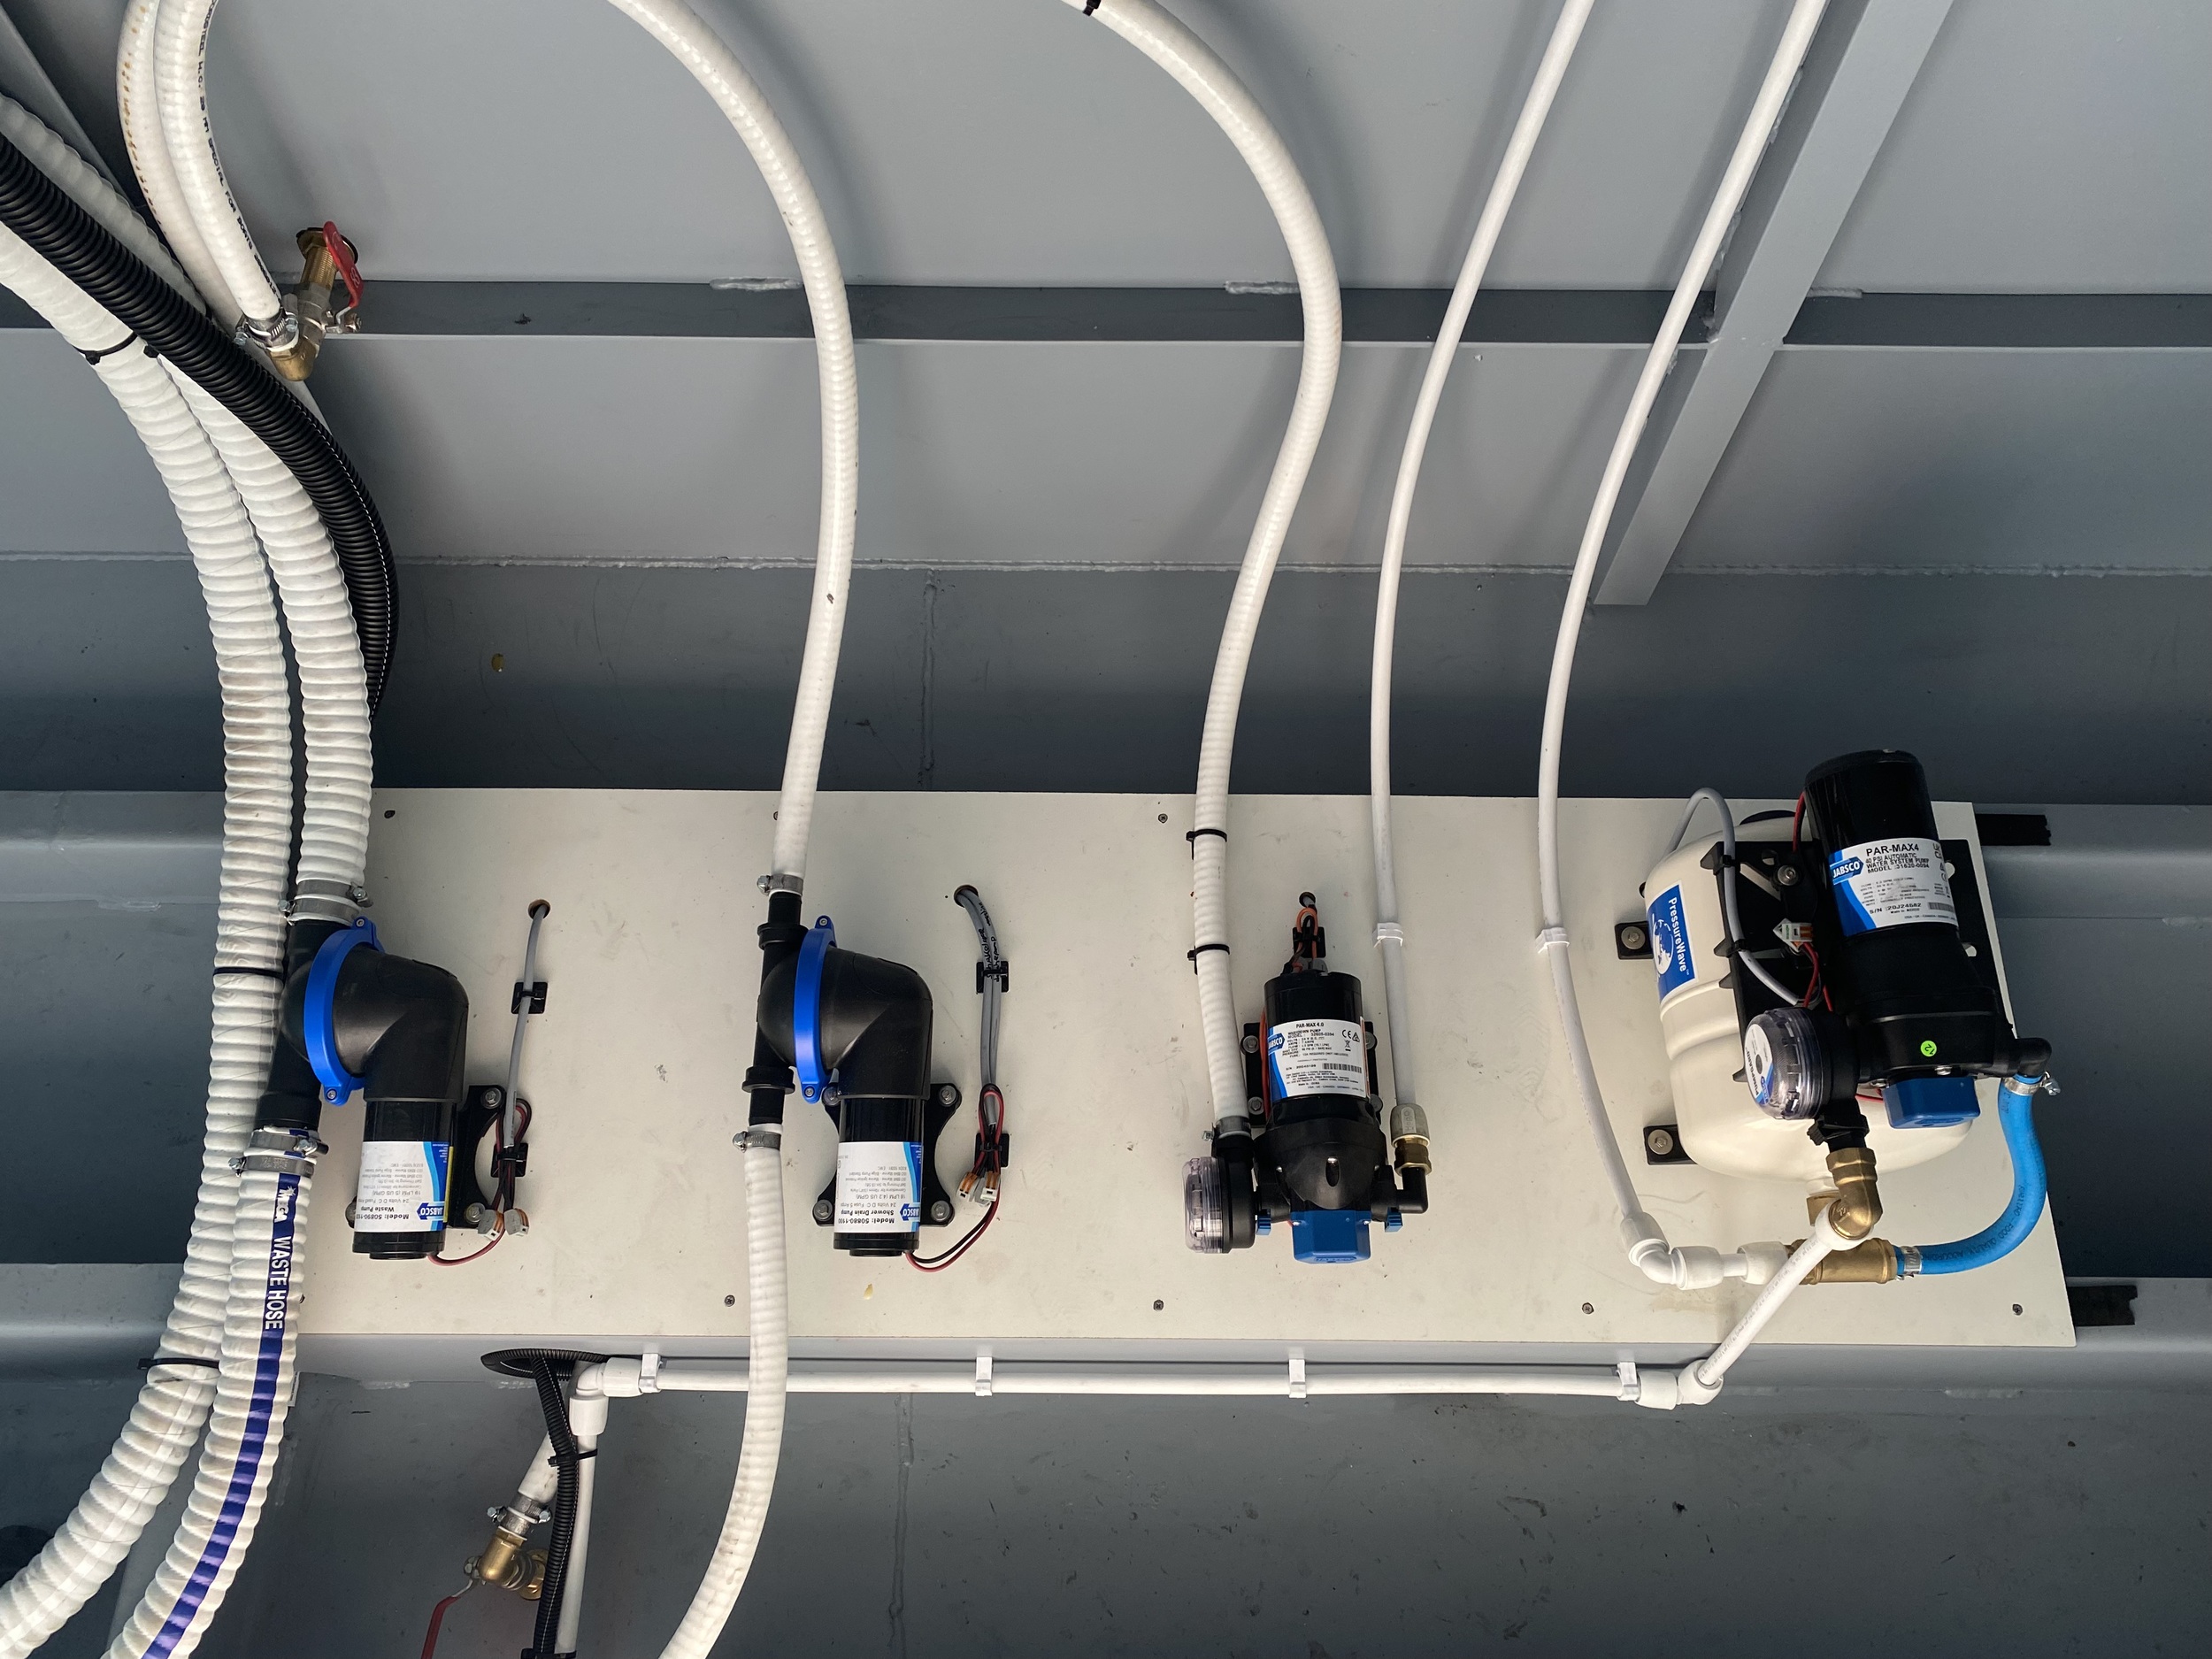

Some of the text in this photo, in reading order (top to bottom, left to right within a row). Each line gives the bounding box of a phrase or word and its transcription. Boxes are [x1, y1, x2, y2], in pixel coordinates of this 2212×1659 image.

[208, 138, 224, 187] SPECIAL
[225, 191, 236, 213] FOR
[237, 216, 253, 250] BOATS
[1866, 843, 1919, 857] PAR-MAX4
[1883, 853, 1917, 861] AUTOMATIC
[1833, 861, 1860, 878] JABSCO
[1668, 897, 1687, 972] PressureWave
[1998, 1223, 2013, 1239] FOOD
[265, 1236, 291, 1329] WASTE HOSE
